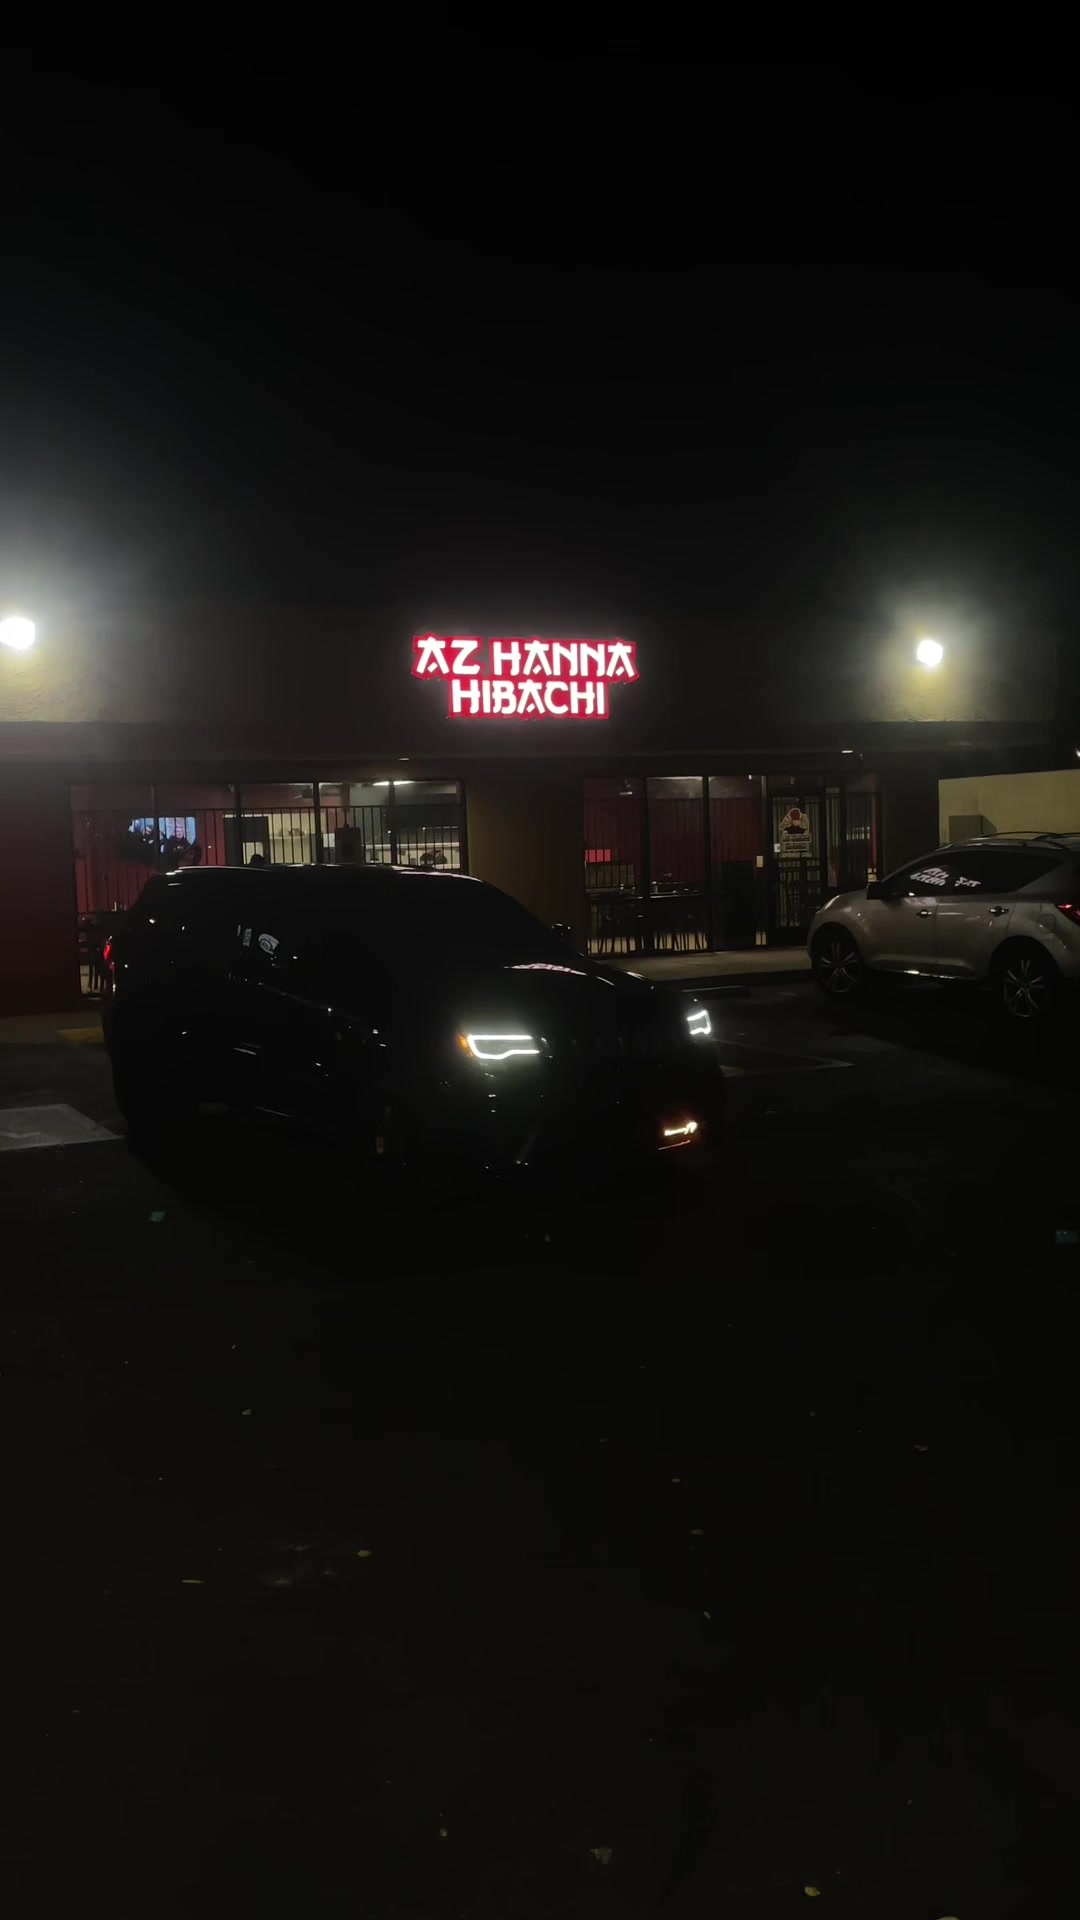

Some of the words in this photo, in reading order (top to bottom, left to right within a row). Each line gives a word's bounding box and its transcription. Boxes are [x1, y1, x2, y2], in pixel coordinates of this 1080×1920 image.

[416, 636, 480, 674] AZ
[493, 640, 635, 677] HANNA
[451, 679, 605, 715] HIBACHI
